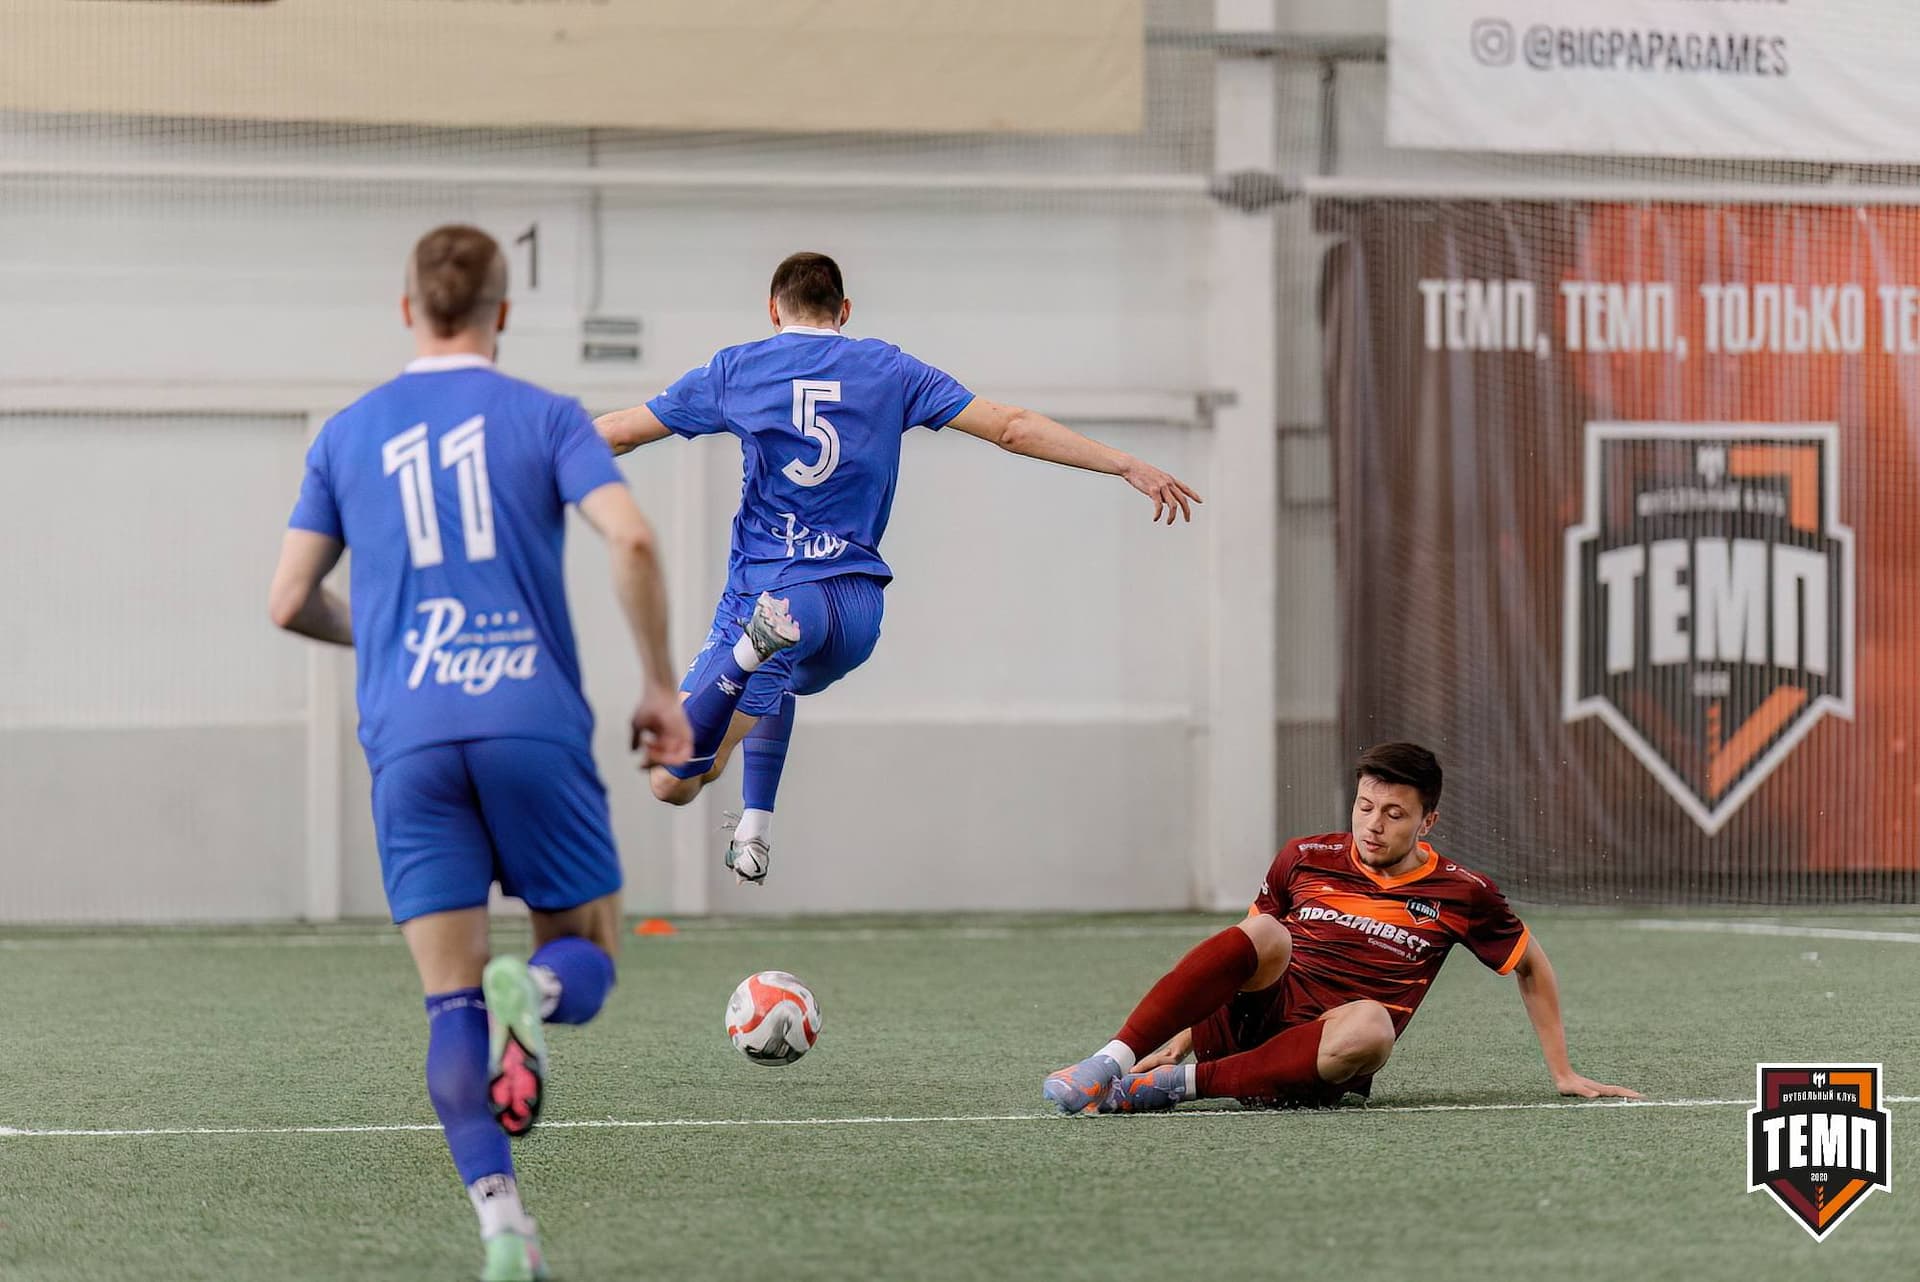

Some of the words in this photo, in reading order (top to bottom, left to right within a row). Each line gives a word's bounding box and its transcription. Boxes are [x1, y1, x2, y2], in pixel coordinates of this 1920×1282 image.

[1523, 24, 1789, 77] @BIGPAPAGAMES
[514, 221, 540, 290] 1
[1419, 278, 1551, 359] ТЕМП,
[1561, 280, 1688, 361] ТЕМП,
[1701, 282, 1867, 354] ТОЛЬКО
[781, 378, 841, 488] 5
[382, 413, 497, 569] 11
[404, 597, 539, 696] Praga
[1597, 536, 1830, 677] ТЕМП
[1298, 907, 1430, 952] ПРОДИНВЕСТ
[1410, 902, 1437, 918] ТЕМП
